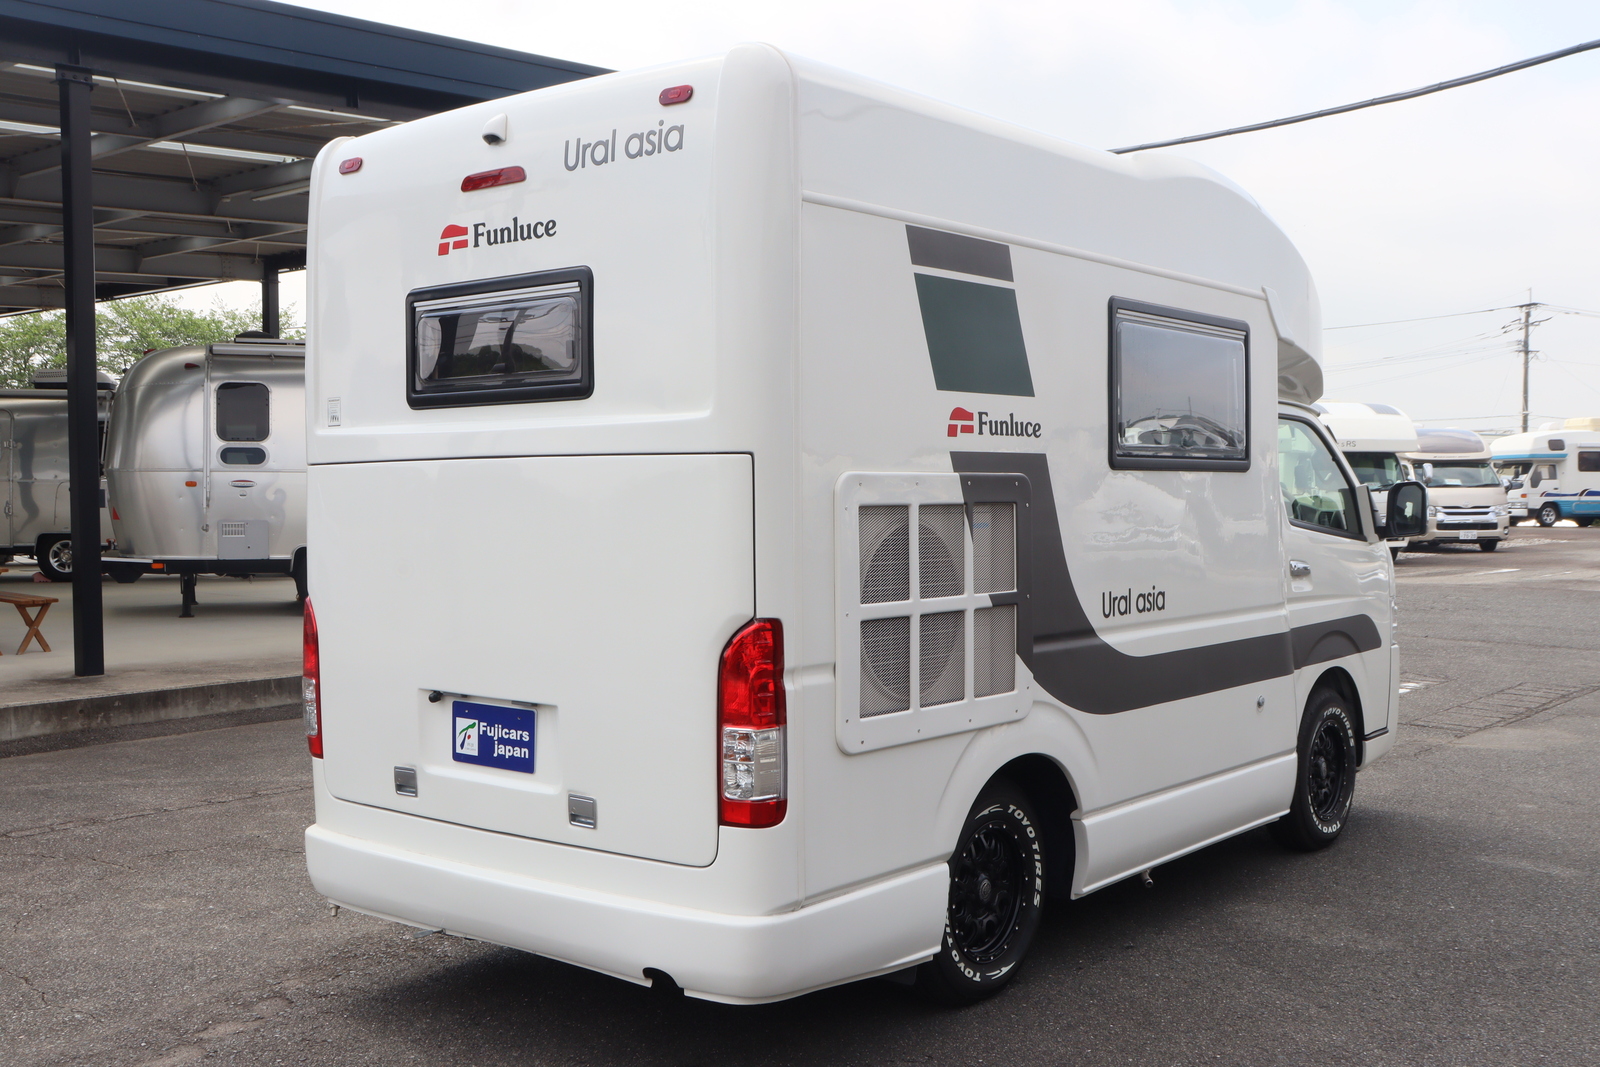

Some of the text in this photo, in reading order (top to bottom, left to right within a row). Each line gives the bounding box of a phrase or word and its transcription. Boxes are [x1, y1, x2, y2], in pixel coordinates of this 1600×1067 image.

[564, 120, 684, 171] Ural asia
[473, 217, 557, 248] Funluce
[978, 412, 1042, 438] Funluce
[1102, 586, 1166, 618] Ural asia
[1323, 707, 1341, 718] TOYO
[480, 722, 530, 742] Fujicars
[493, 741, 529, 759] japan
[1007, 804, 1042, 908] TOYO TIRES
[951, 949, 981, 982] TOYO
